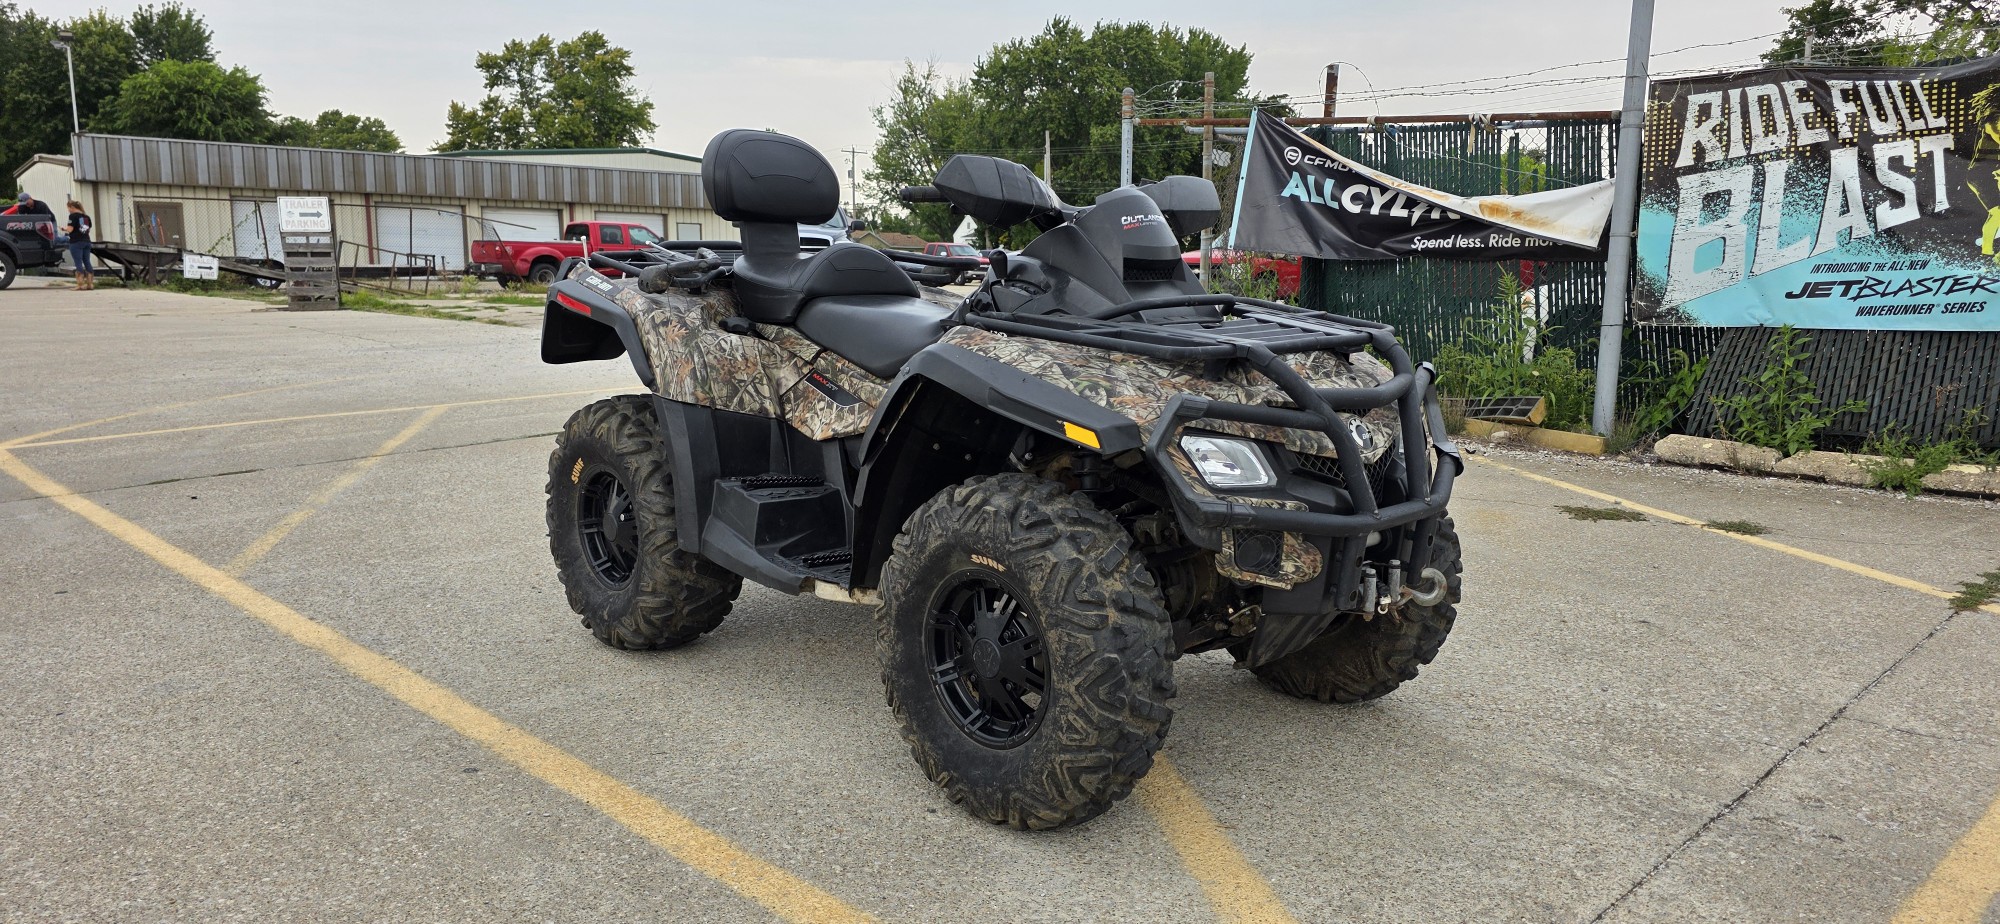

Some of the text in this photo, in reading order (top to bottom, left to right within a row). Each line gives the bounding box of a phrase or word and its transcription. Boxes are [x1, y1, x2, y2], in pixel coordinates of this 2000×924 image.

[1674, 79, 1947, 169] RIDE FULL
[283, 199, 324, 209] TRAILER
[285, 219, 326, 229] PARKING
[1123, 222, 1140, 230] MAX
[1657, 133, 1955, 311] BLAST
[1411, 235, 1454, 251] Spend
[1456, 233, 1485, 248] less.
[1489, 233, 1521, 248] Ride
[1810, 259, 1931, 274] INTRODUCING THE ALL-NEW
[1941, 301, 1988, 314] SERIES
[571, 457, 584, 484] SUNF
[970, 554, 1007, 572] SUNF
